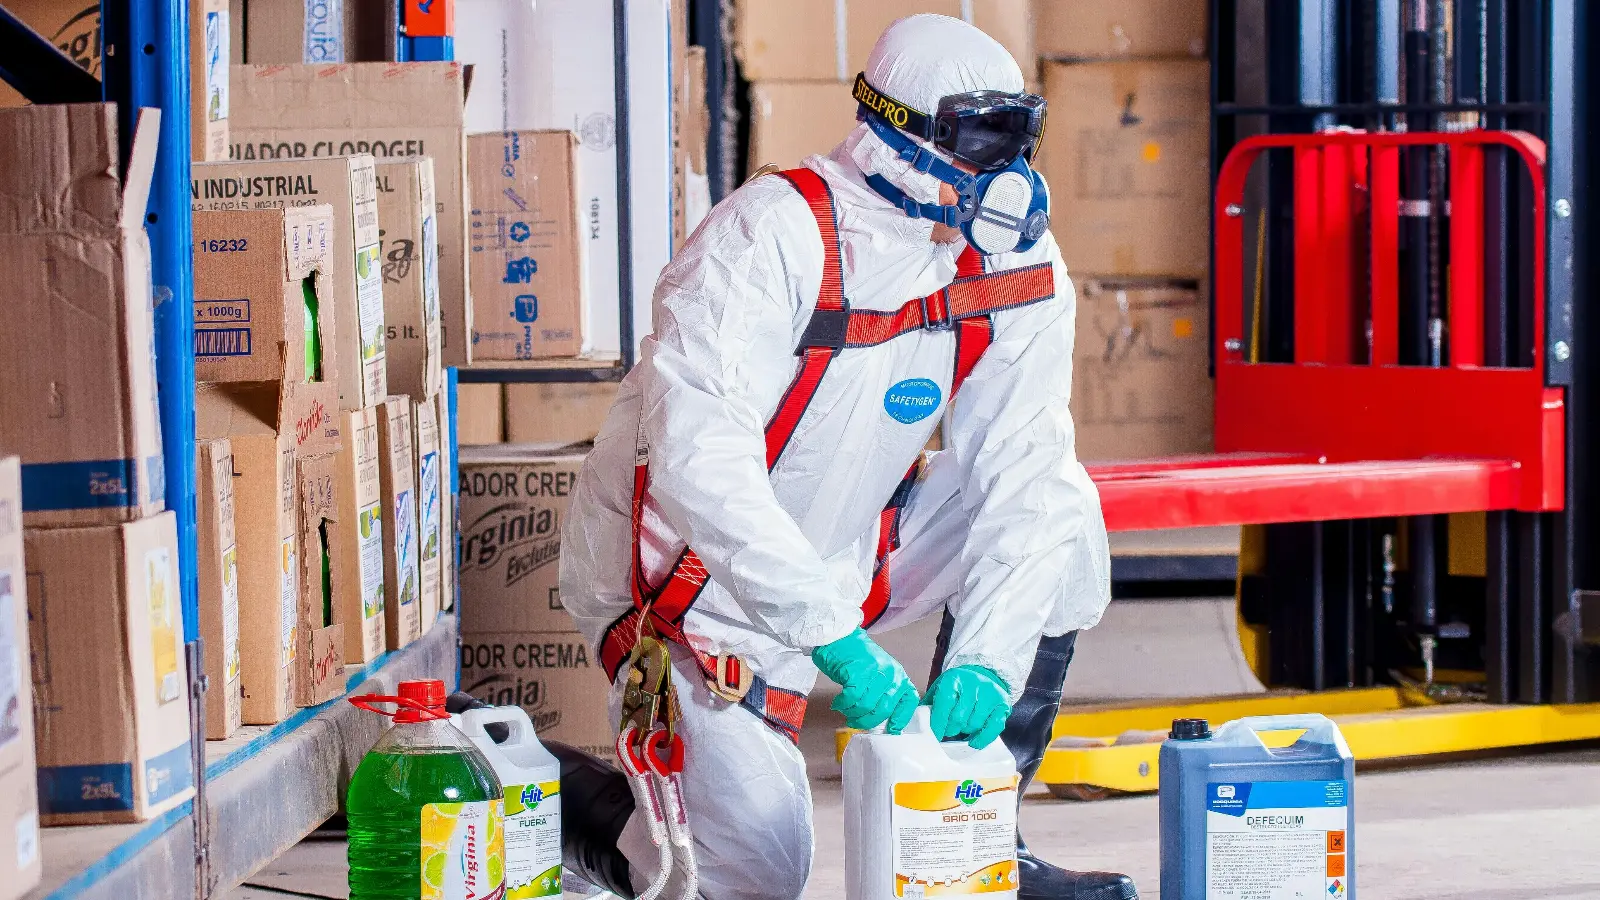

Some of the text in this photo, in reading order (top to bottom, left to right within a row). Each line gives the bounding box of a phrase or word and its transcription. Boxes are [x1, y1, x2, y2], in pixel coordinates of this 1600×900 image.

[855, 79, 908, 128] STEELPRO
[204, 174, 318, 199] INDUSTRIAL
[200, 238, 248, 252] 16232
[207, 306, 242, 318] 1000g
[513, 644, 588, 669] CREMA
[520, 787, 543, 803] Hit
[955, 783, 983, 799] Hit
[519, 817, 548, 828] FUERA
[971, 812, 997, 821] 1000
[465, 825, 479, 899] Virginia
